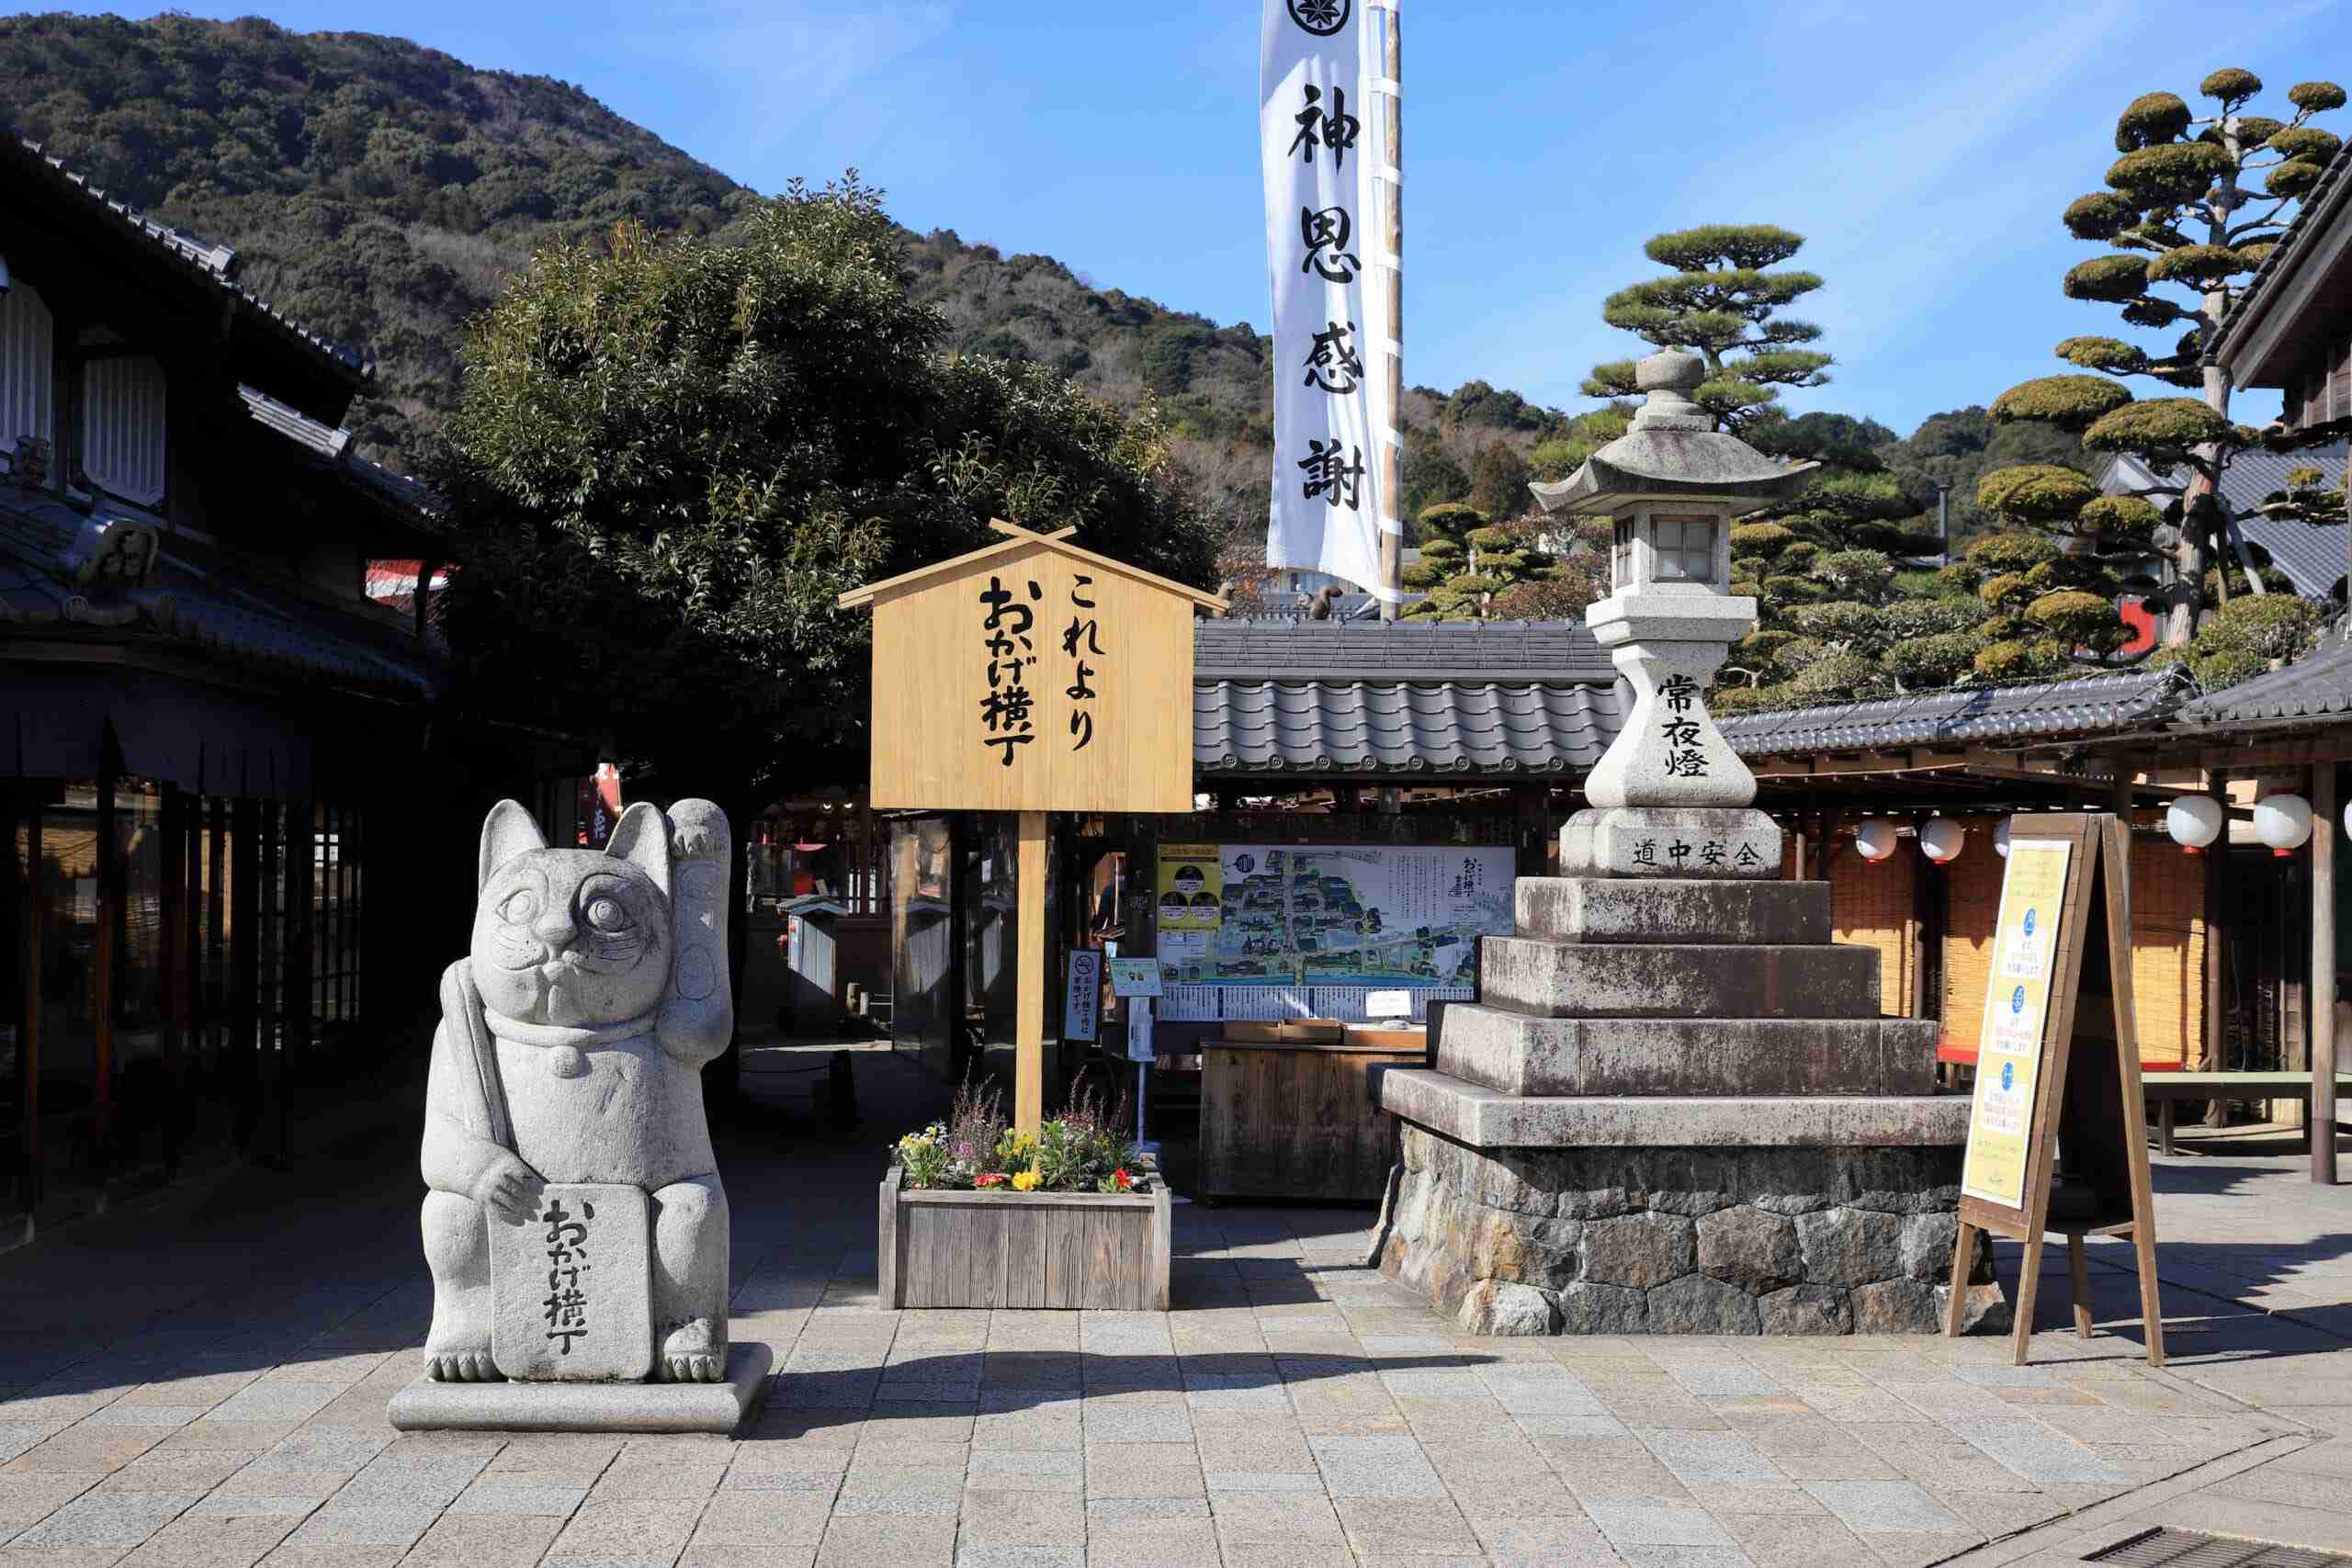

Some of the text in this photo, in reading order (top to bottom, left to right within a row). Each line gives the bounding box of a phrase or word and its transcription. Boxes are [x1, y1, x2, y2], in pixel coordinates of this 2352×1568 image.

[1288, 84, 1365, 511] 神恩感謝
[979, 577, 1042, 766] おかげ横丁
[1062, 573, 1106, 751] これより
[1657, 673, 1710, 777] 常夜燈
[1632, 838, 1762, 866] 道中安全
[543, 1200, 595, 1356] おかげ横丁
